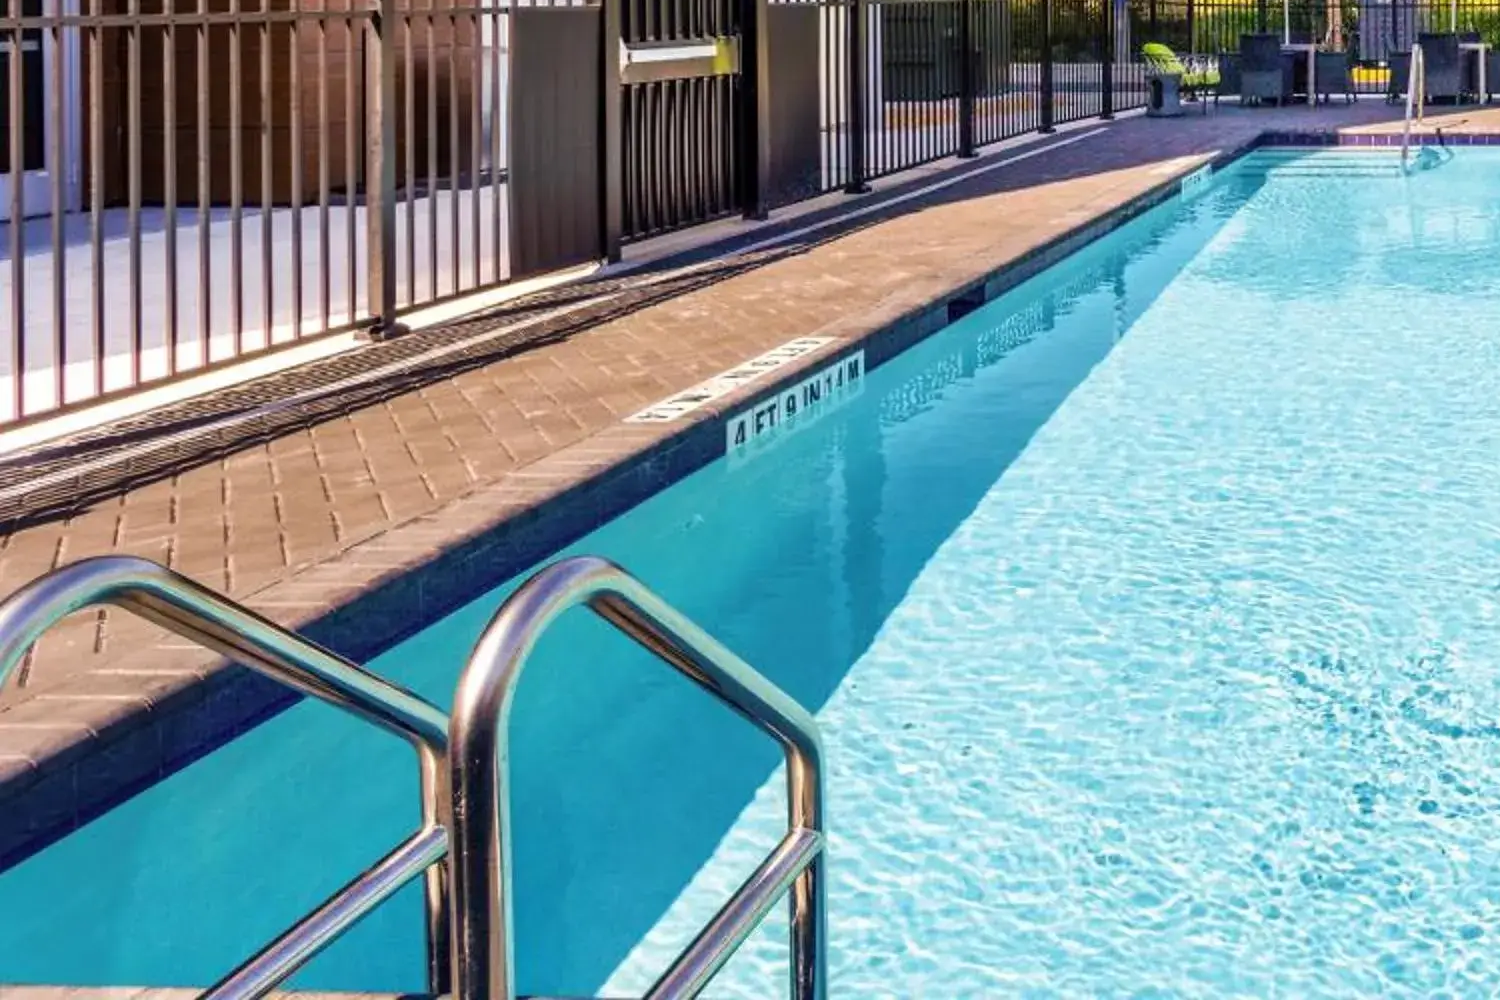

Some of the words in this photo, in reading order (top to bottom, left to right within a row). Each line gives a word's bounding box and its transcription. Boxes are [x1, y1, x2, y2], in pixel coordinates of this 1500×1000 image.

[735, 420, 746, 445] 4
[755, 403, 777, 434] FT
[803, 379, 820, 407] IN
[847, 359, 859, 382] M
